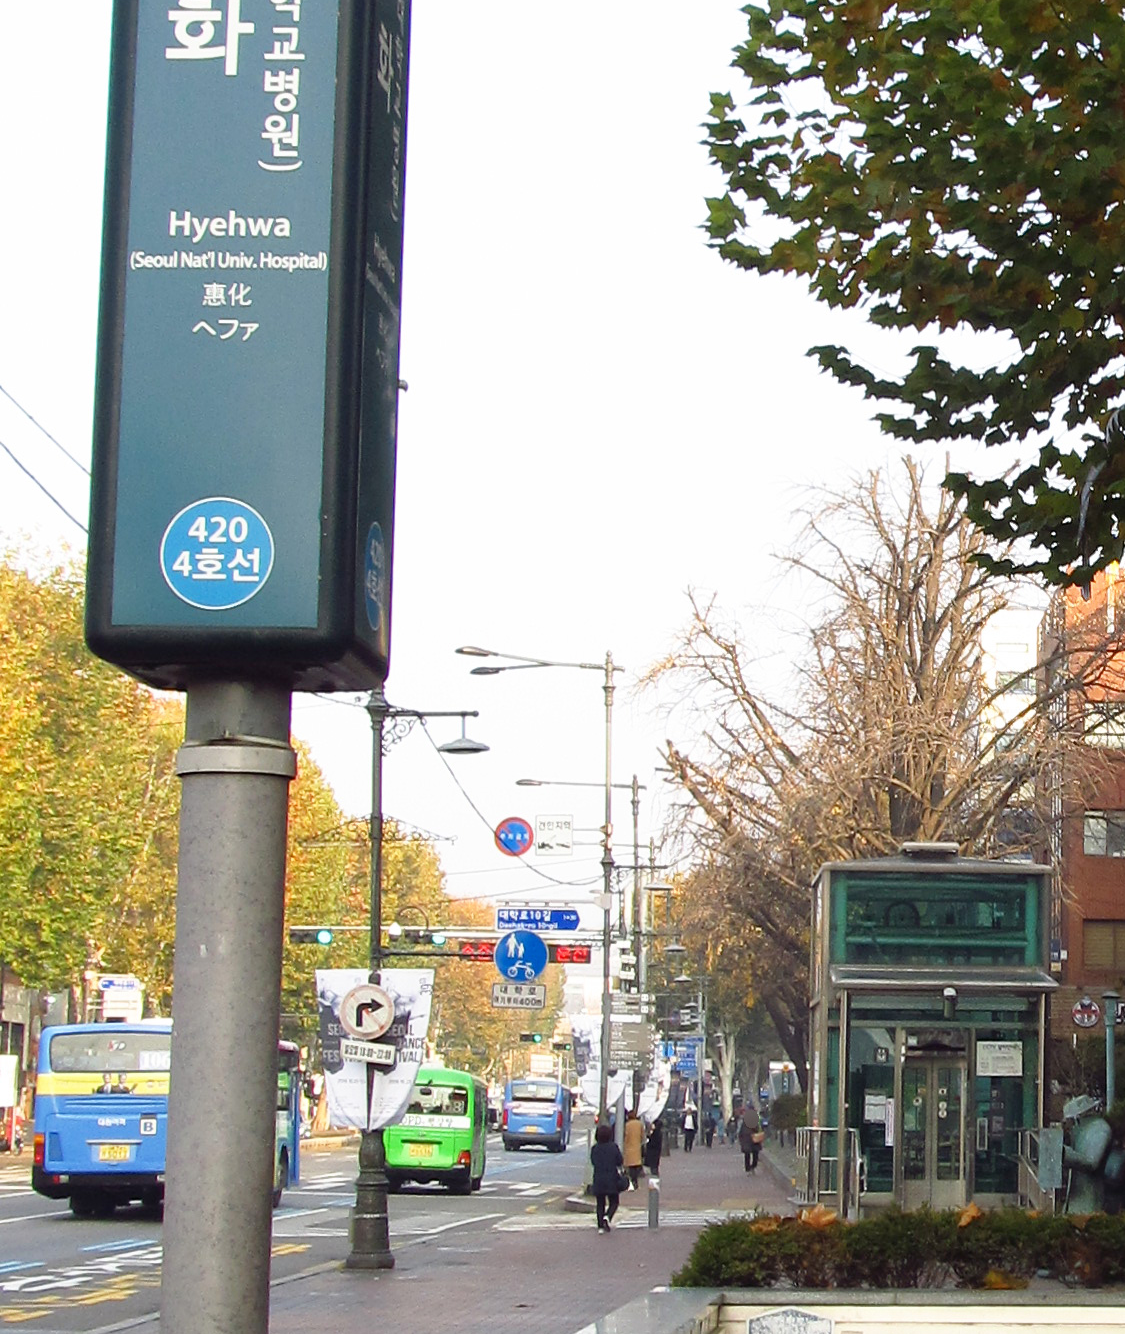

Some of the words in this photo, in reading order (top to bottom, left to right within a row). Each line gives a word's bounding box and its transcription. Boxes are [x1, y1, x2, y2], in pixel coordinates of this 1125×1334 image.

[168, 210, 292, 243] Hyehwa
[130, 250, 179, 271] (Seoul
[180, 251, 216, 269] Nat'l
[218, 251, 257, 269] Univ.
[259, 251, 328, 271] Hospital)
[202, 282, 253, 307] 惠化
[191, 318, 260, 341] ヘファ
[187, 515, 249, 543] 420
[172, 546, 261, 583] 4호선
[142, 1121, 154, 1132] B
